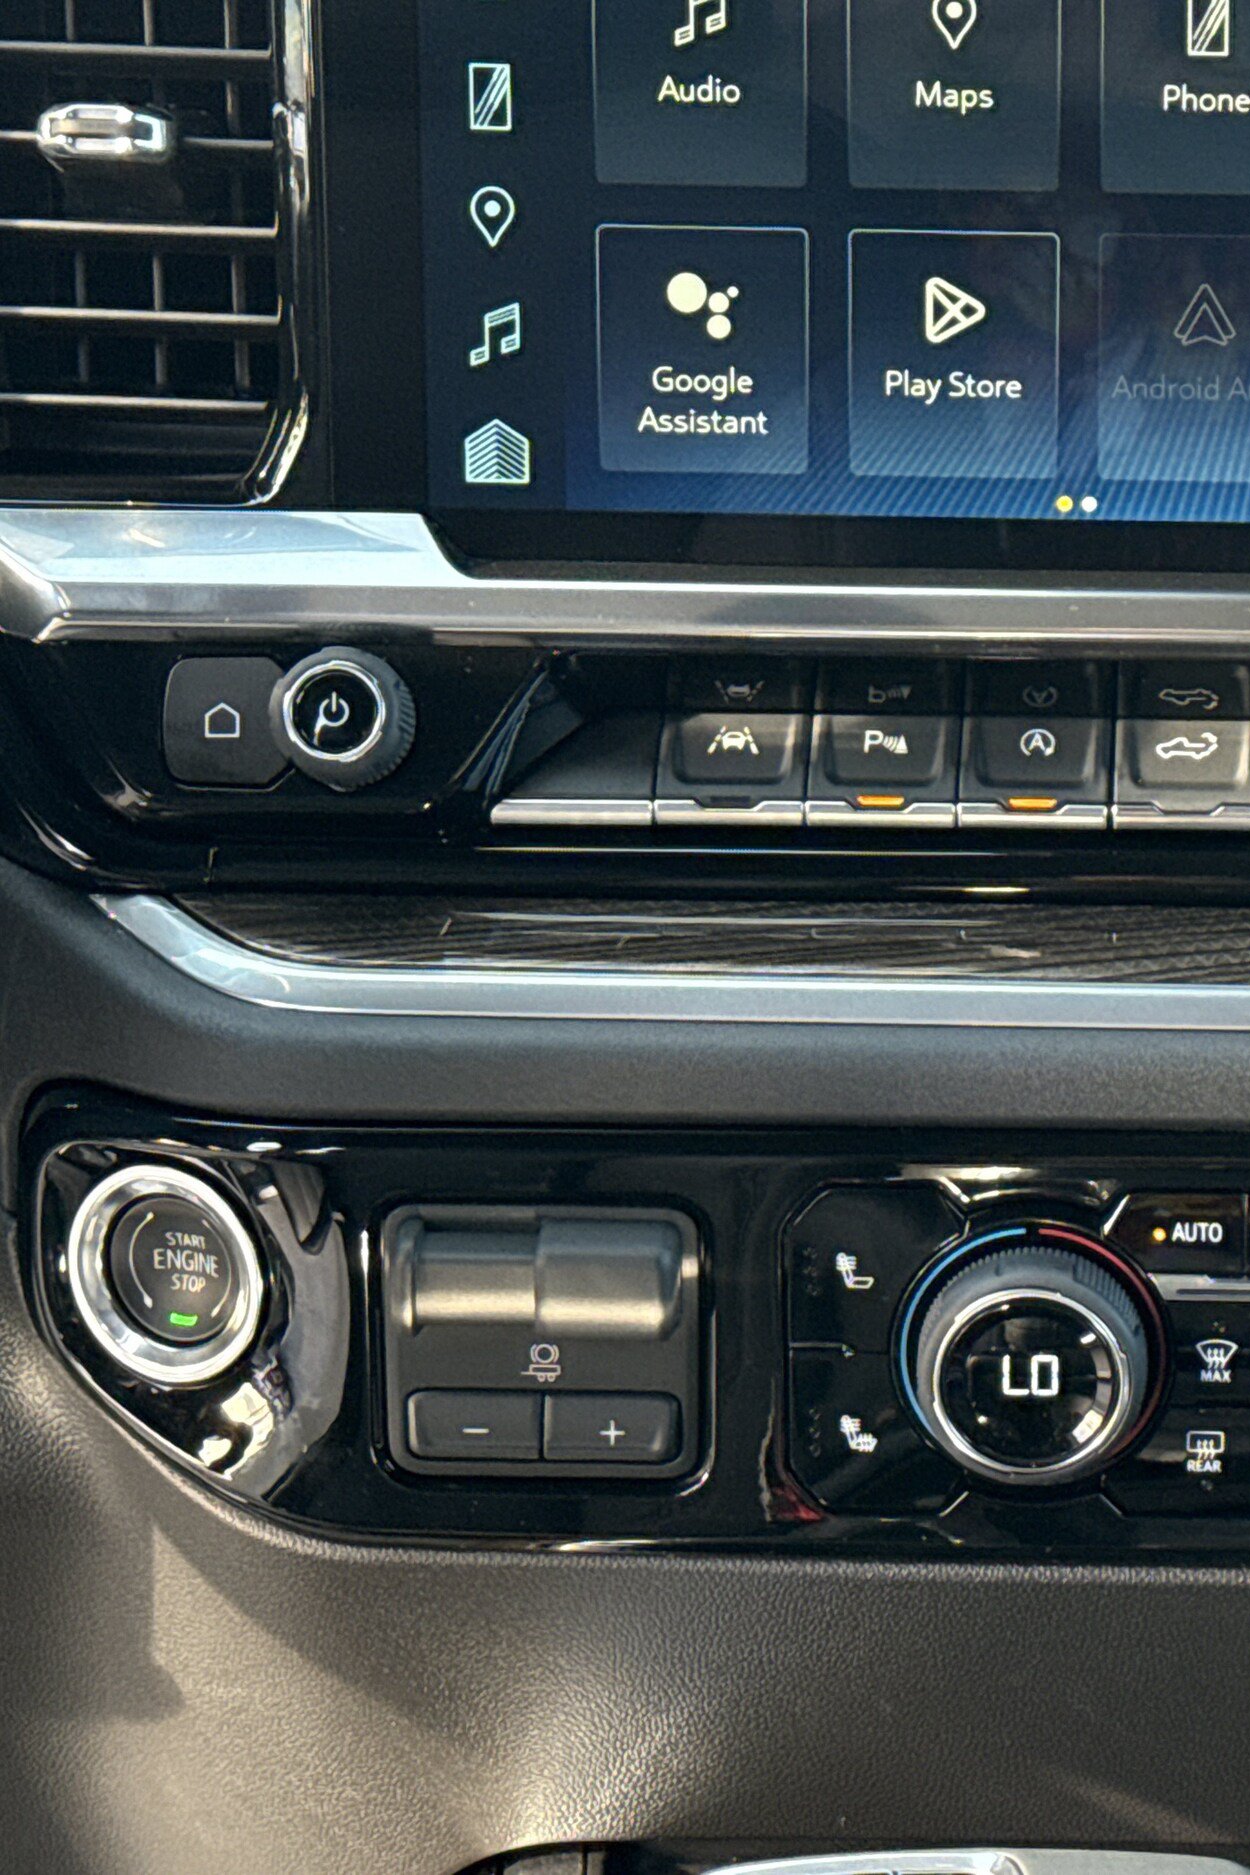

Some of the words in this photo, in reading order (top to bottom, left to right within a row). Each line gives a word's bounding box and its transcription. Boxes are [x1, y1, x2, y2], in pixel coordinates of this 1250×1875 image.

[658, 76, 740, 104] Audio
[915, 83, 994, 114] Maps
[1163, 85, 1250, 113] Phone
[652, 367, 753, 401] Google
[885, 371, 941, 402] Play
[949, 373, 1023, 400] Store
[1112, 374, 1224, 400] Android
[638, 407, 768, 436] Assistant
[165, 1231, 206, 1248] START
[1172, 1223, 1223, 1243] AUTO
[153, 1248, 219, 1277] ENGINE
[170, 1274, 206, 1293] STOP
[1002, 1354, 1059, 1397] LO
[1201, 1368, 1231, 1383] MAX
[1187, 1459, 1221, 1473] REAR
